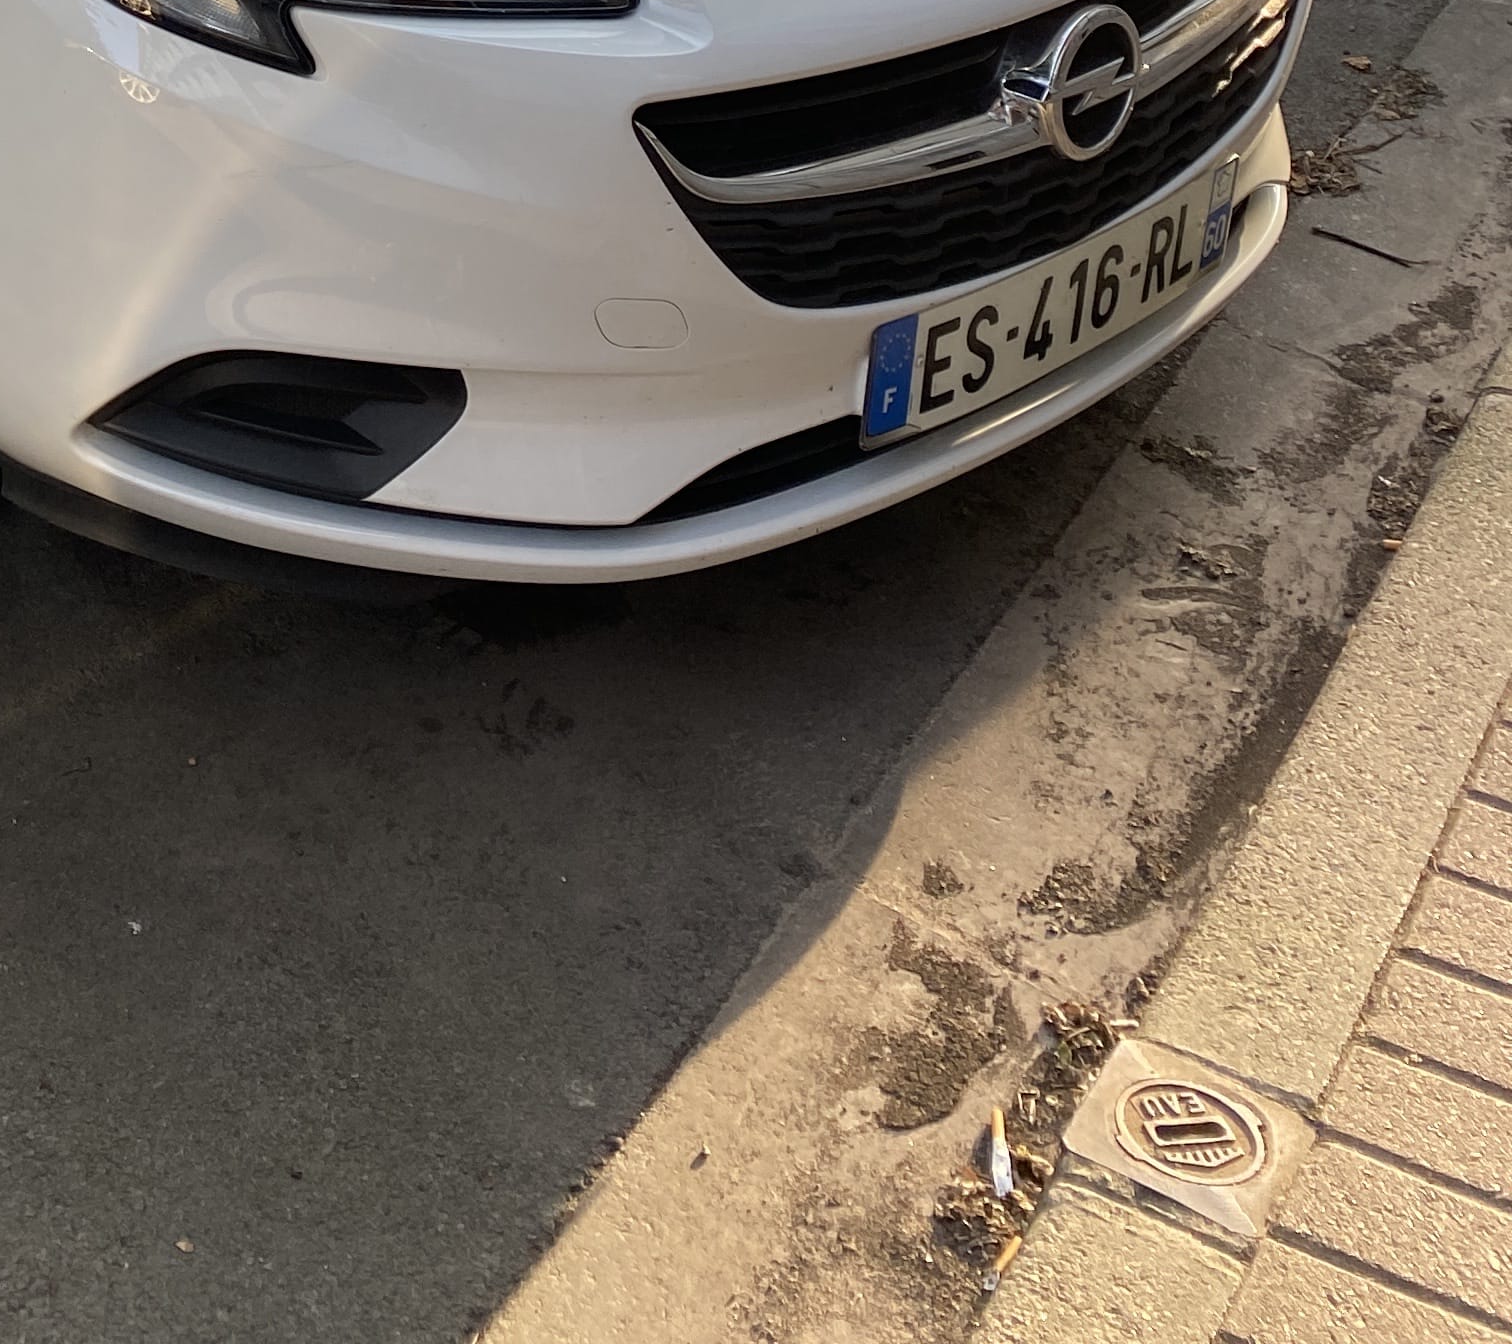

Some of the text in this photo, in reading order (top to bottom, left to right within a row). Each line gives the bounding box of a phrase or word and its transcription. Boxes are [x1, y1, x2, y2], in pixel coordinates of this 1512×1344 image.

[882, 203, 1227, 414] F ES-416-RL 60
[1141, 1092, 1206, 1118] EAU
